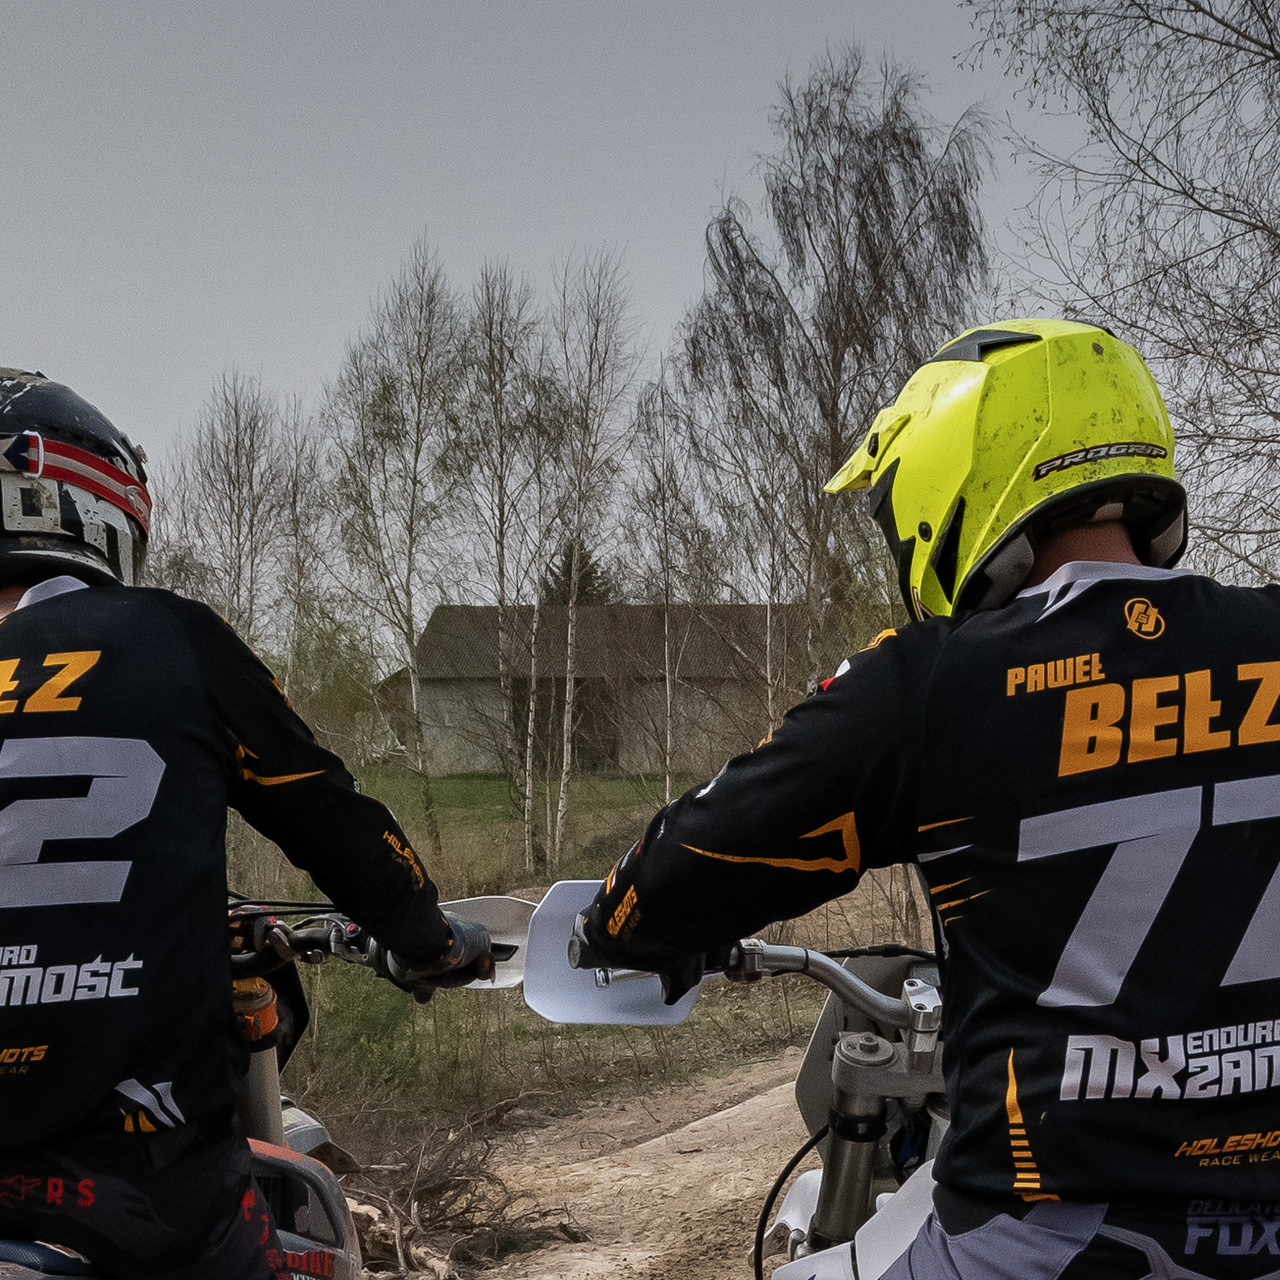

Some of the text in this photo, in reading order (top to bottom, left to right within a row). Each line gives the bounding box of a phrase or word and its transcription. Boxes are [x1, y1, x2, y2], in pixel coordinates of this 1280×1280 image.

[1036, 444, 1167, 480] PROGRIP
[1006, 652, 1106, 697] PAWEŁ
[1059, 1034, 1186, 1101] MX
[1199, 1153, 1241, 1167] RACE
